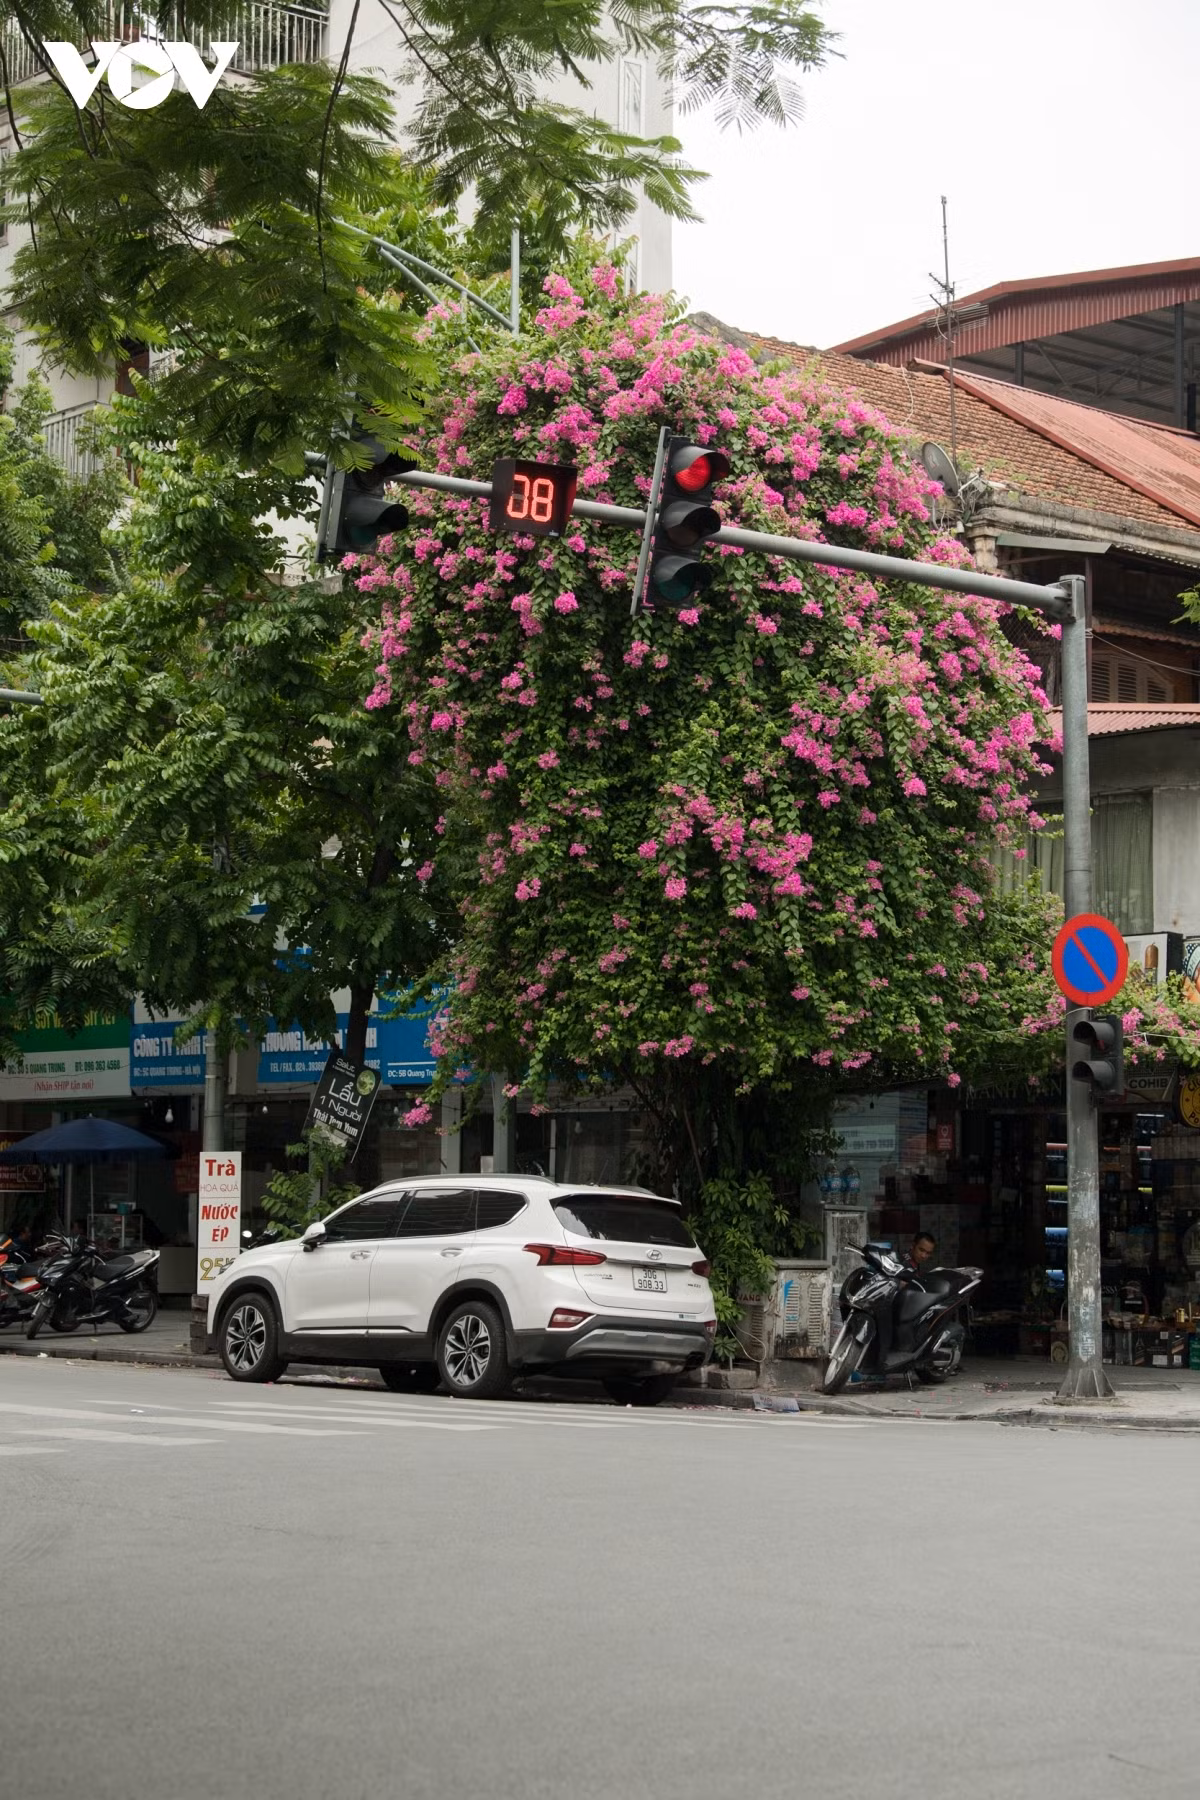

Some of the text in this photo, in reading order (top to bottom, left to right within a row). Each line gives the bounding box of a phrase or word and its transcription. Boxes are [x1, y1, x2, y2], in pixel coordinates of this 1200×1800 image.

[407, 1069, 426, 1079] Quang
[329, 1078, 362, 1107] Lẩu
[328, 1099, 363, 1122] Người
[343, 1121, 358, 1137] Yum
[205, 1159, 236, 1177] Trà
[200, 1184, 218, 1193] HOA
[642, 1269, 657, 1280] 30G
[637, 1278, 664, 1291] 908.33
